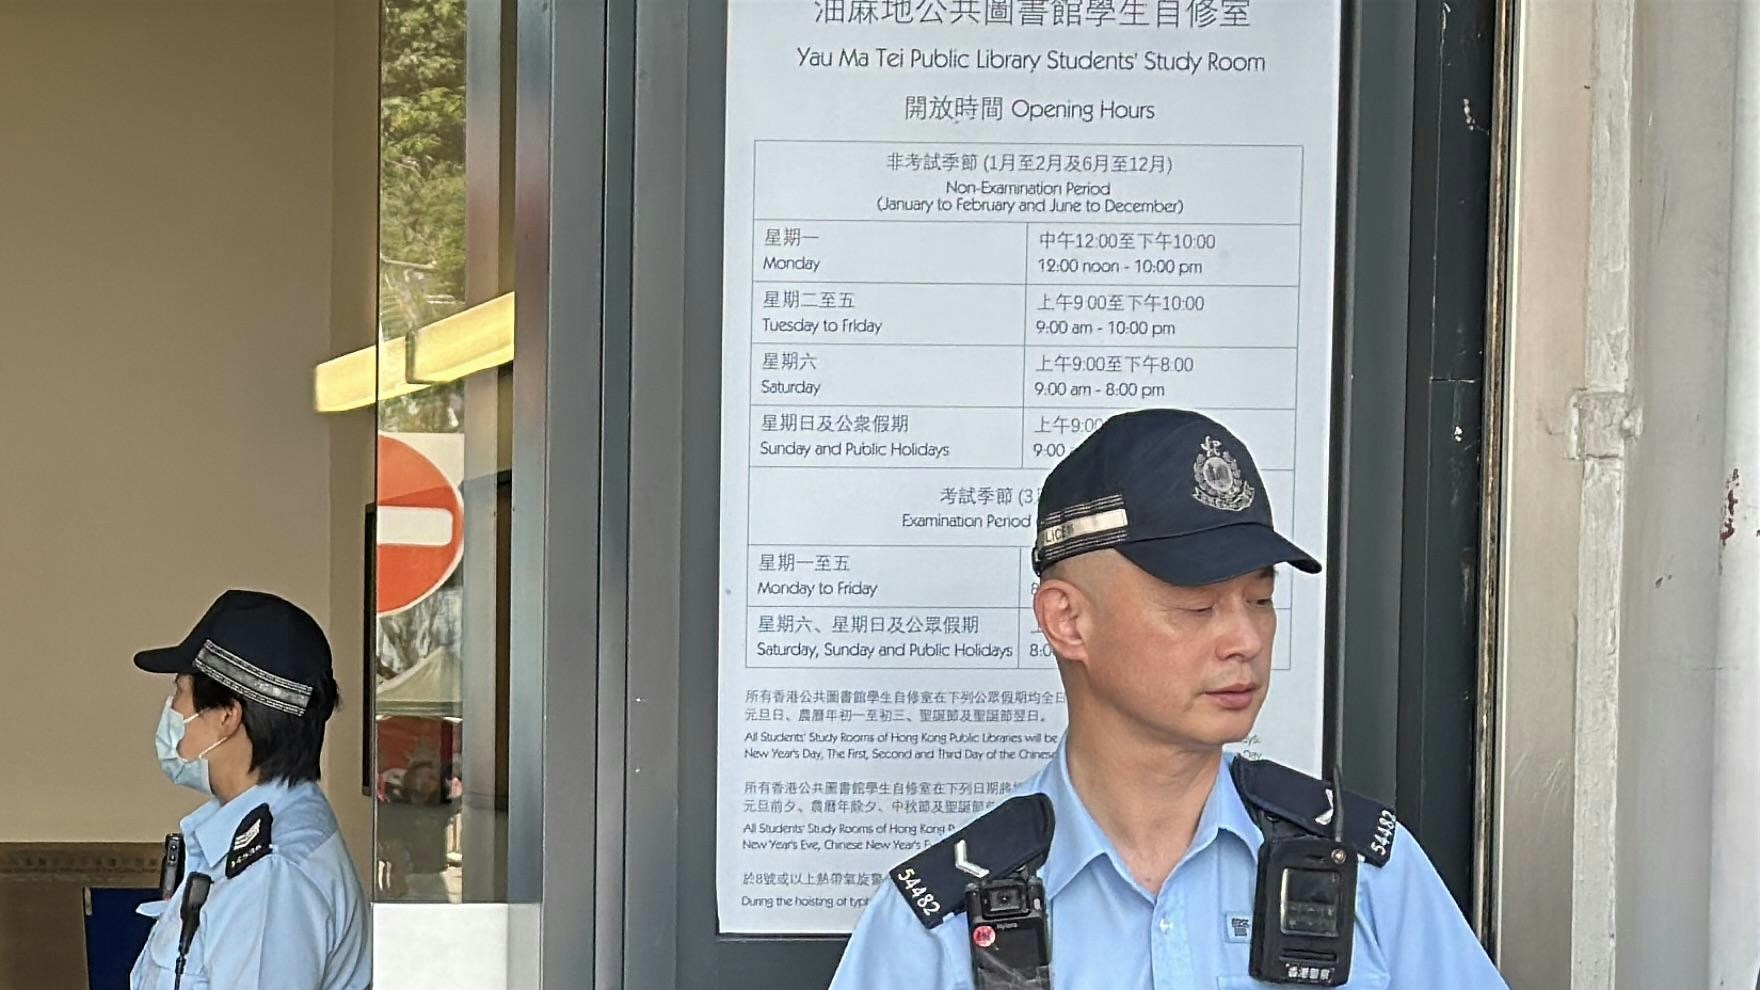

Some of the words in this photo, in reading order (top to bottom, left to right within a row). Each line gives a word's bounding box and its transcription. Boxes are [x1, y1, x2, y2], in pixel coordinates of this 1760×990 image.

[815, 0, 1251, 28] 油麻地公共圖書館學生自修室
[797, 47, 833, 67] Yau
[839, 48, 869, 67] Ma
[875, 48, 905, 68] Tei
[911, 49, 970, 69] Public
[977, 49, 1041, 73] Library
[1047, 49, 1138, 71] Students'
[1144, 51, 1202, 75] Study
[1208, 51, 1266, 72] Room
[905, 95, 1004, 121] 開放時間
[1012, 99, 1094, 122] Opening
[1101, 100, 1156, 119] Hours
[887, 152, 978, 172] 非考試季節
[983, 153, 1173, 175] (1月至2月及6月至12月)
[946, 180, 1062, 196] Non-Examination
[1066, 181, 1111, 196] Period
[877, 196, 934, 213] (January
[938, 198, 952, 211] to
[956, 198, 1015, 214] February
[1018, 199, 1045, 212] and
[1049, 199, 1081, 213] June
[1086, 200, 1101, 213] to
[1104, 200, 1184, 215] December)
[764, 228, 820, 247] 星期一
[1039, 231, 1216, 250] 中午12:00至下午10:00
[763, 256, 821, 273] Monday
[1038, 258, 1079, 274] 12:00
[1082, 261, 1120, 274] noon
[1136, 259, 1175, 274] 10:00
[1179, 262, 1203, 277] pm
[763, 290, 856, 309] 星期二至五
[763, 318, 819, 335] Tuesday
[823, 319, 838, 333] to
[842, 319, 882, 335] Friday
[1036, 320, 1069, 335] 9:00
[1072, 323, 1093, 335] am
[1108, 321, 1149, 336] 10:00
[1152, 323, 1176, 338] pm
[762, 352, 818, 371] 星期六
[761, 379, 821, 397] Saturday
[1034, 382, 1067, 397] 9:00
[1070, 385, 1092, 397] am
[1105, 382, 1138, 397] 8:00
[1141, 385, 1165, 399] pm
[760, 441, 811, 458] Sunday
[815, 443, 842, 457] and
[845, 442, 887, 457] Public
[890, 442, 950, 459] Holidays
[1033, 443, 1066, 458] 9:00
[939, 486, 1014, 506] 考試季節
[902, 513, 983, 528] Examination
[986, 513, 1032, 528] Period
[759, 552, 850, 572] 星期一至五
[757, 581, 816, 597] Monday
[819, 582, 834, 595] to
[838, 581, 878, 597] Friday
[757, 642, 819, 659] Saturday,
[824, 642, 875, 659] Sunday
[878, 643, 906, 657] and
[909, 642, 951, 657] Public
[954, 642, 1014, 659] Holidays
[744, 732, 758, 742] All
[809, 732, 838, 745] Study
[841, 733, 875, 743] Rooms
[877, 732, 888, 743] of
[891, 733, 918, 745] Hong
[921, 733, 947, 745] Kong
[949, 733, 979, 743] Public
[982, 733, 1022, 743] Libraries
[1025, 733, 1042, 743] will
[1044, 733, 1057, 744] be
[744, 748, 768, 759] New
[772, 748, 800, 759] Year's
[802, 749, 824, 761] Day,
[827, 748, 845, 759] The
[848, 749, 869, 761] First,
[872, 749, 912, 759] Second
[914, 750, 934, 760] and
[938, 749, 962, 760] Third
[965, 750, 983, 761] Day
[986, 749, 998, 760] of
[999, 750, 1016, 760] the
[744, 781, 1017, 796] 所有香港公共圖書館學生自修室在下列日期將
[743, 823, 756, 834] All
[807, 823, 836, 836] Study
[840, 824, 874, 834] Rooms
[876, 823, 887, 834] of
[890, 824, 917, 836] Hong
[920, 824, 945, 835] Kong
[1370, 810, 1397, 857] 54482
[743, 839, 766, 849] New
[769, 839, 798, 849] Year's
[800, 840, 821, 851] Eve,
[824, 840, 863, 850] Chinese
[865, 840, 890, 849] New
[893, 840, 921, 850] Year's
[898, 869, 941, 917] 54482
[742, 896, 774, 909] During
[776, 896, 794, 906] the
[795, 896, 833, 909] hoisting
[836, 896, 847, 906] of
